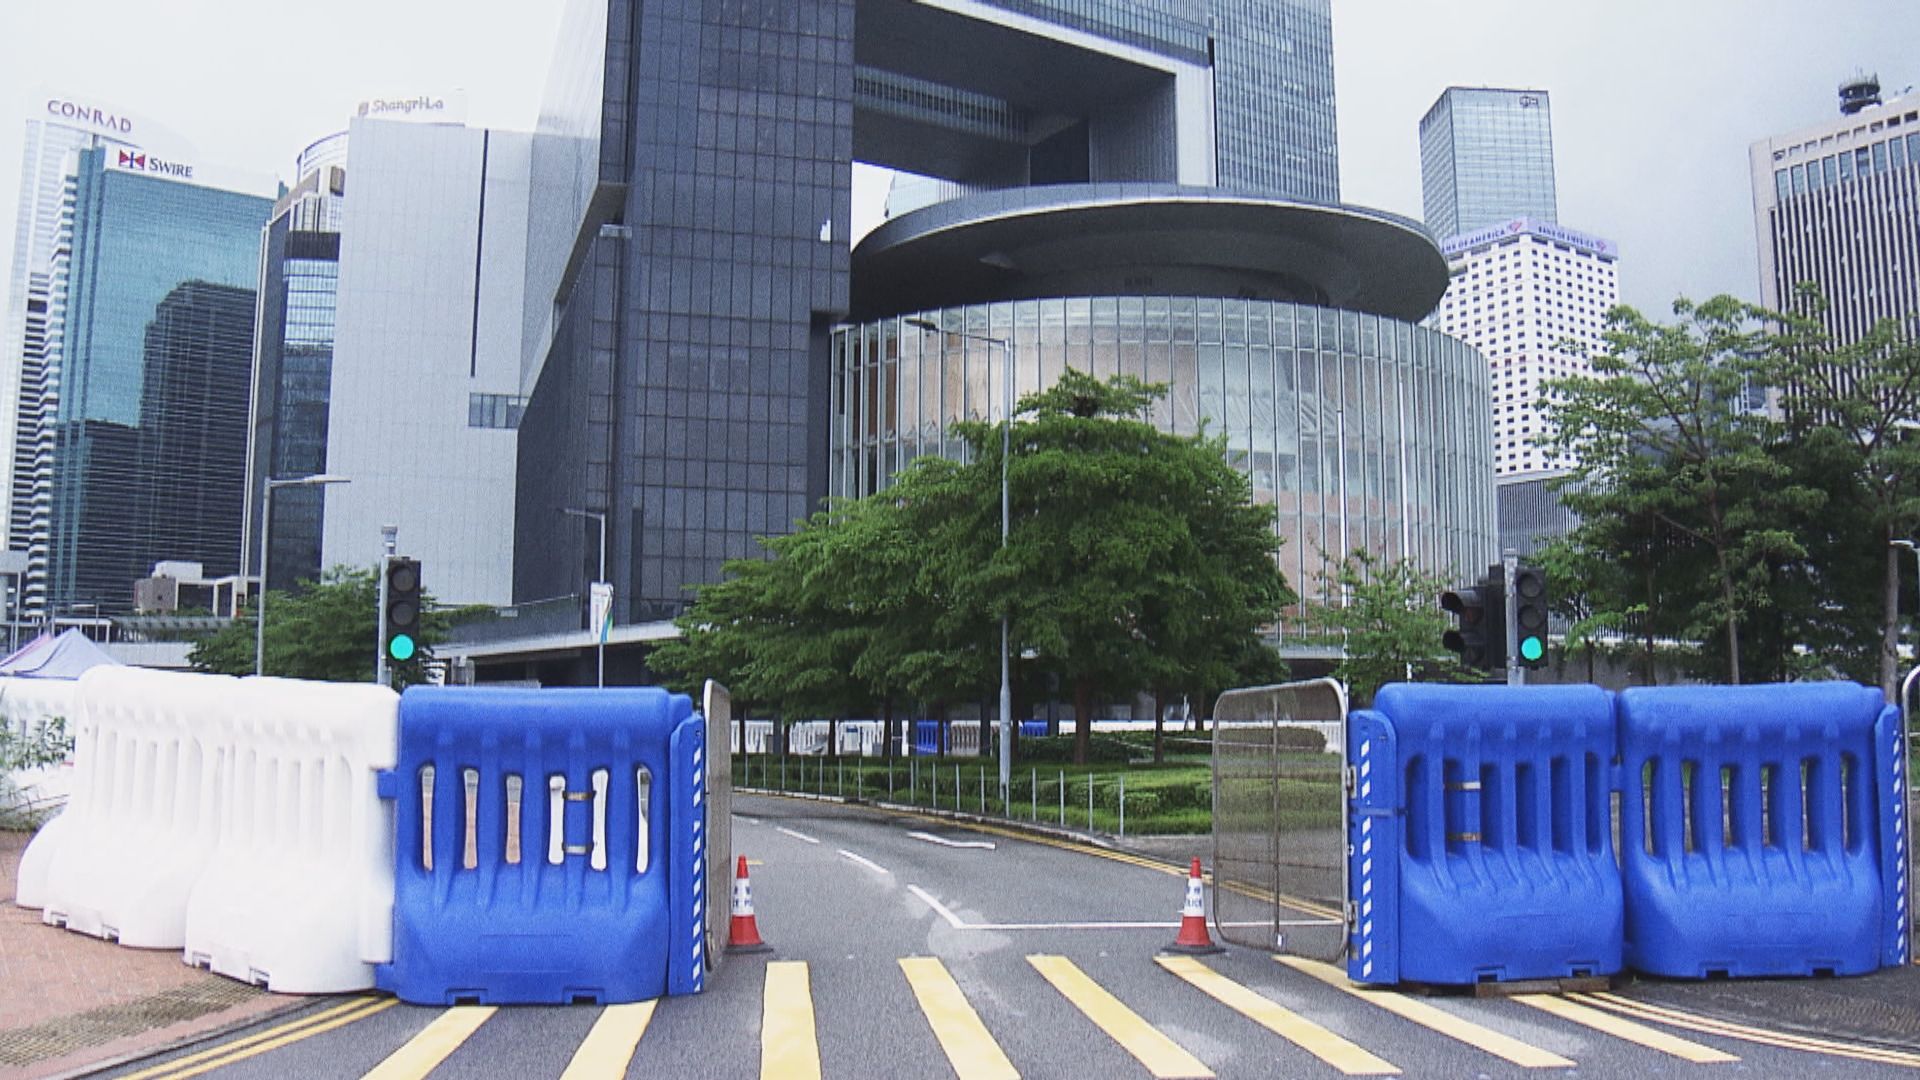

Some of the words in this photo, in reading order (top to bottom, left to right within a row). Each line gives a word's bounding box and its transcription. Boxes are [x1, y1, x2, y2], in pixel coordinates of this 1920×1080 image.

[372, 96, 443, 113] Shangri-La
[48, 100, 132, 133] CONRAD
[149, 157, 193, 178] SWIRE
[1470, 229, 1505, 244] AMERICA
